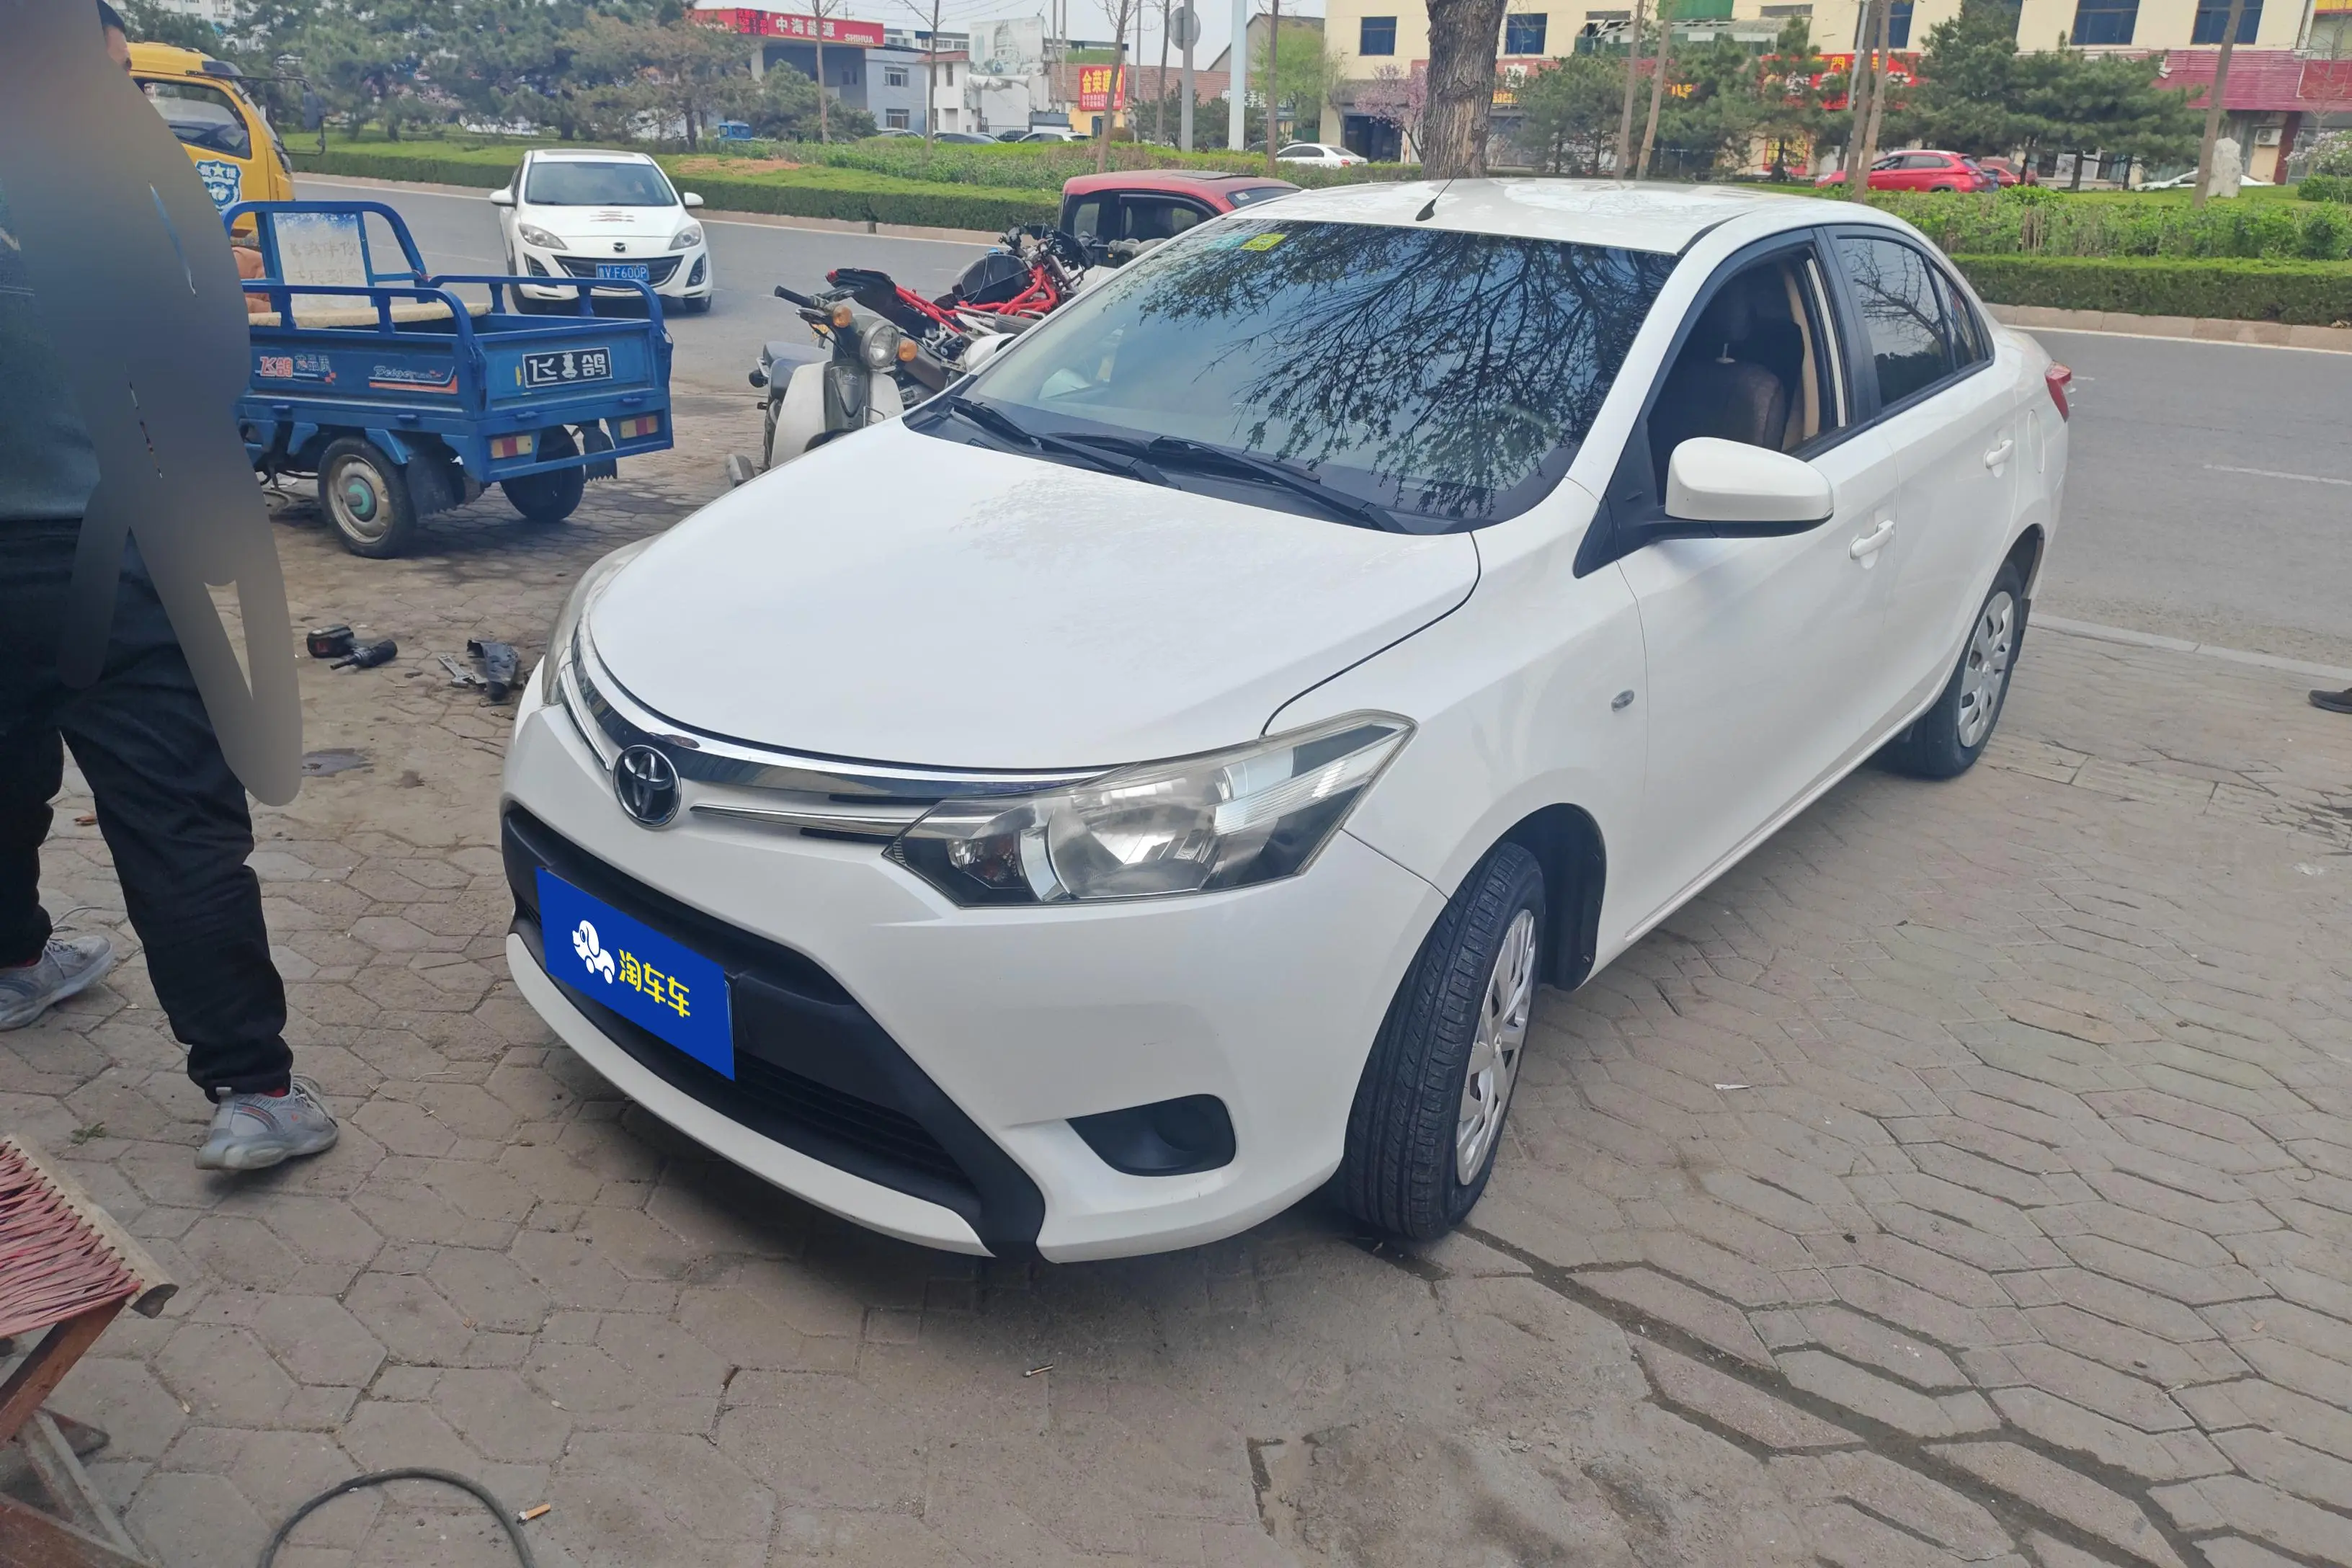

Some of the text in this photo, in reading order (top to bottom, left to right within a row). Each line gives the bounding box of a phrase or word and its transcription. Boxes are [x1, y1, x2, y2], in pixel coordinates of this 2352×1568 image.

[775, 16, 835, 37] 中海能源
[844, 33, 874, 44] SHIHUA
[529, 353, 607, 382] 飞鸽
